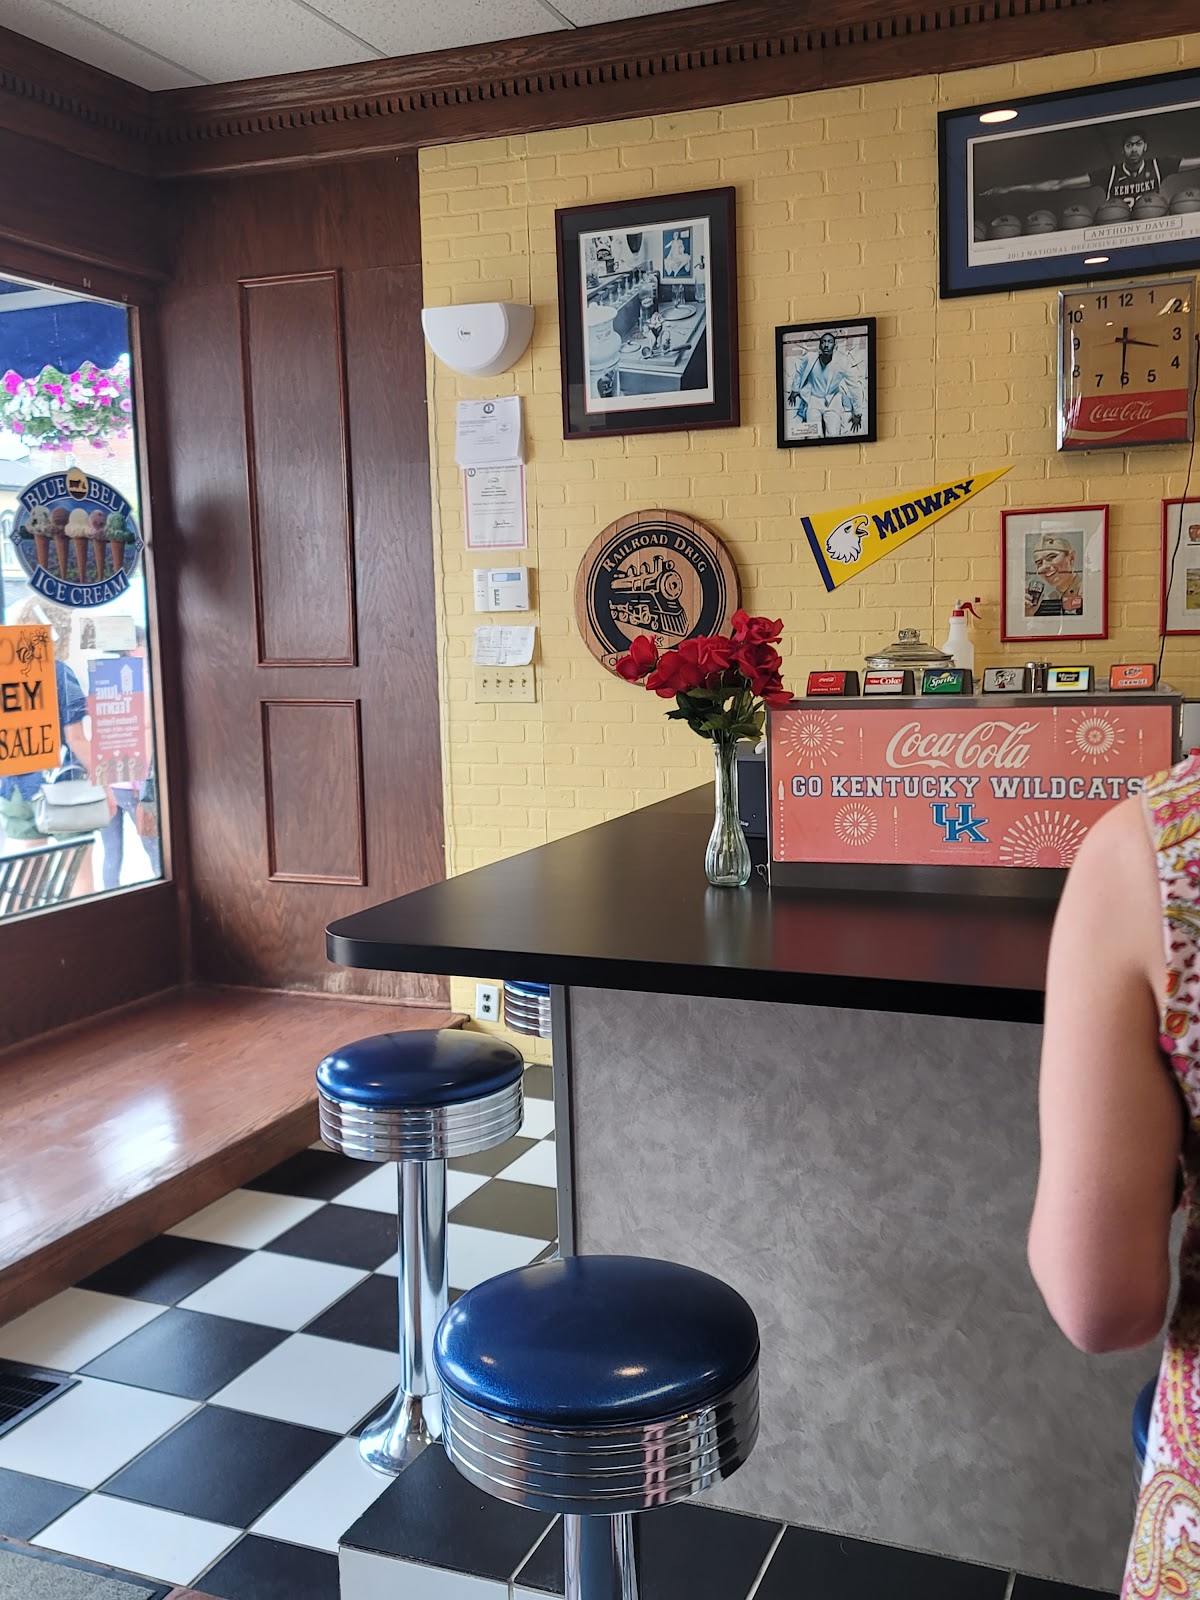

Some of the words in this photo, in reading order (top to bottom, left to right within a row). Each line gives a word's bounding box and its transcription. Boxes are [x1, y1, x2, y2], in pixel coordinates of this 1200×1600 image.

[1114, 179, 1155, 196] KENTUCKY
[1091, 224, 1141, 238] ANTHONY
[1145, 219, 1176, 231] DAVIS
[1026, 246, 1067, 257] NATIONAL
[1071, 239, 1116, 251] DEFENSIVE
[1120, 233, 1153, 244] PLAYER
[1169, 229, 1185, 238] THE
[1096, 295, 1108, 309] 11
[1119, 293, 1134, 308] 12
[1149, 290, 1155, 304] 1
[1173, 299, 1182, 313] 2
[1068, 310, 1083, 323] 10
[1172, 327, 1182, 341] 3
[1073, 337, 1081, 350] 9
[1072, 364, 1081, 378] 8
[1171, 355, 1180, 369] 4
[1095, 374, 1104, 387] 7
[1120, 372, 1129, 385] 6
[1147, 369, 1156, 383] 5
[1090, 400, 1154, 424] Coca-Cola
[23, 477, 67, 508] BLUE
[89, 478, 127, 520] BELL
[871, 479, 974, 541] MIDWAY
[601, 534, 669, 573] RAILROAD
[673, 536, 708, 573] DRUG
[35, 572, 67, 601] ICE
[70, 575, 127, 605] CREAM
[880, 676, 902, 685] Coke
[930, 675, 955, 687] Sprite
[0, 723, 54, 761] SALE
[886, 721, 1040, 769] Coca-Cola
[791, 775, 823, 798] GO
[830, 775, 980, 799] KENTUCKY
[989, 775, 1144, 800] WILDCATS
[929, 802, 990, 843] UK
